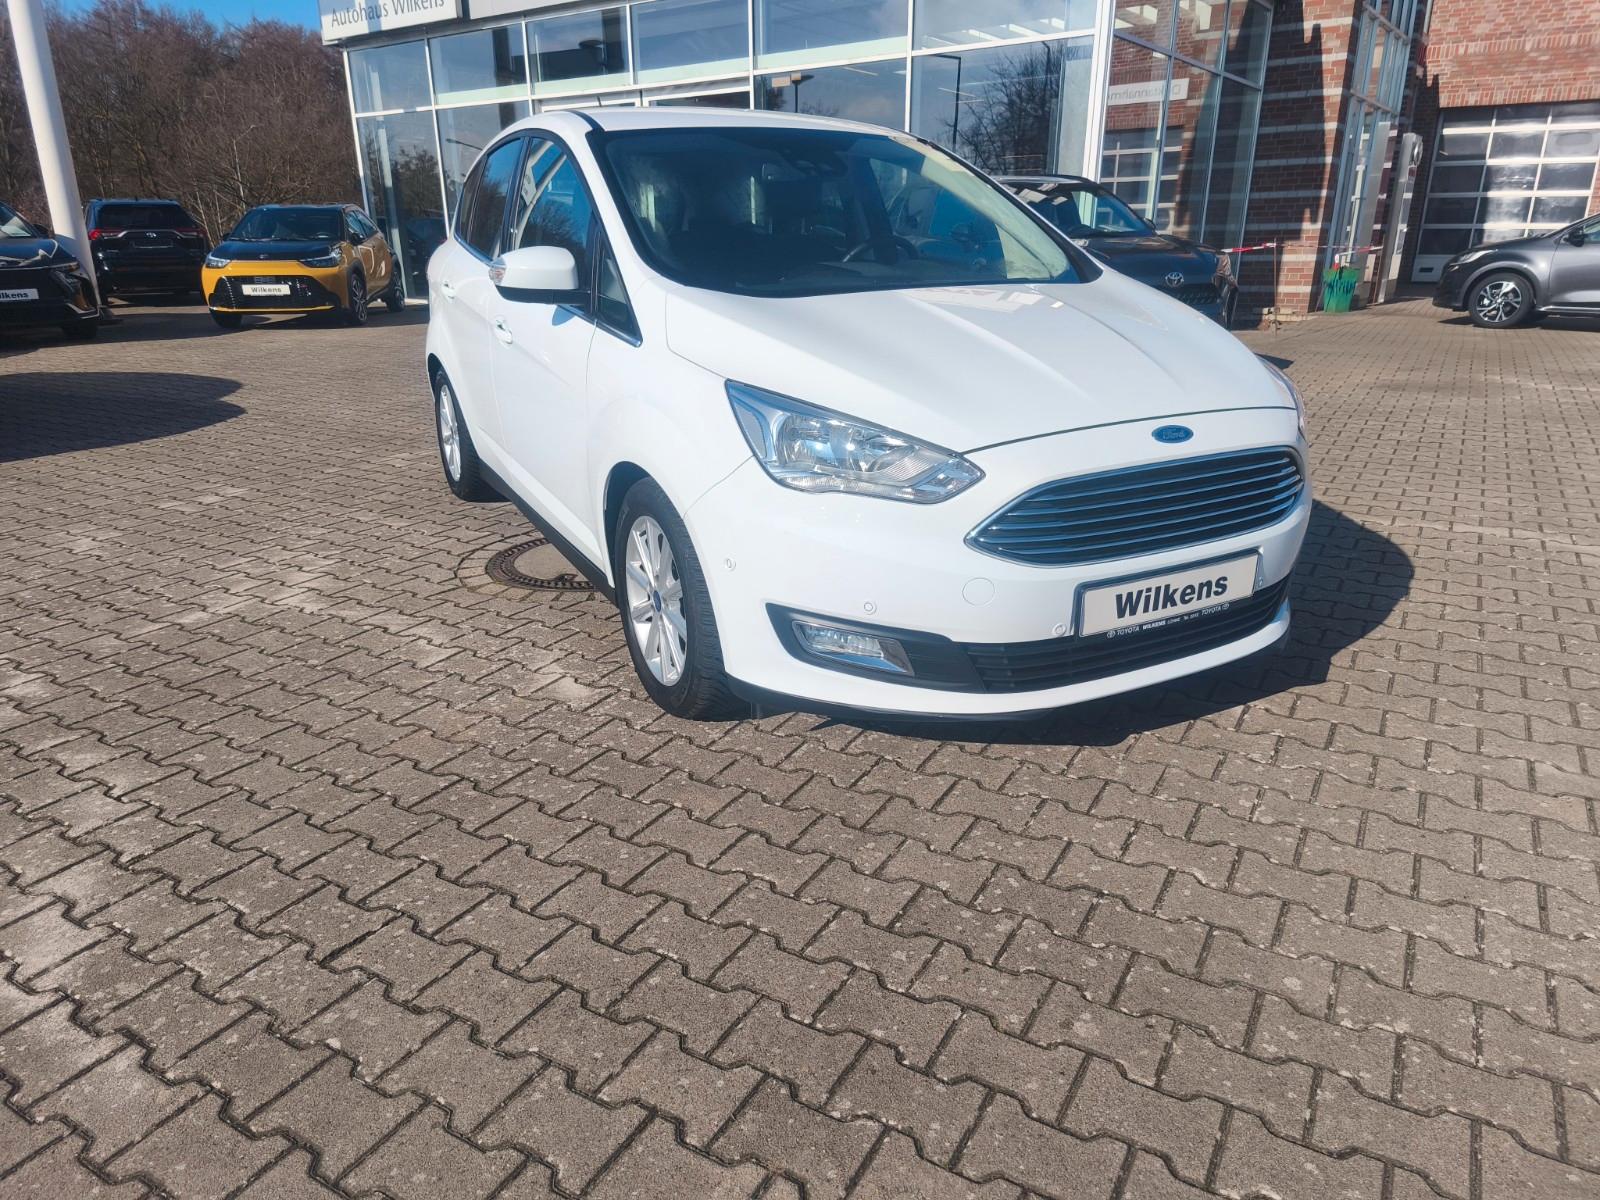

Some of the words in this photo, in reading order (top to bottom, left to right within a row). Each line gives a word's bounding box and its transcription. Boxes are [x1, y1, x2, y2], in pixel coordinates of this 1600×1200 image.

[331, 3, 389, 27] Autohaus
[0, 291, 29, 299] ilkens
[1116, 576, 1228, 619] Wilkens
[1117, 626, 1140, 635] TOYOTA
[1201, 606, 1221, 615] TOYOTA
